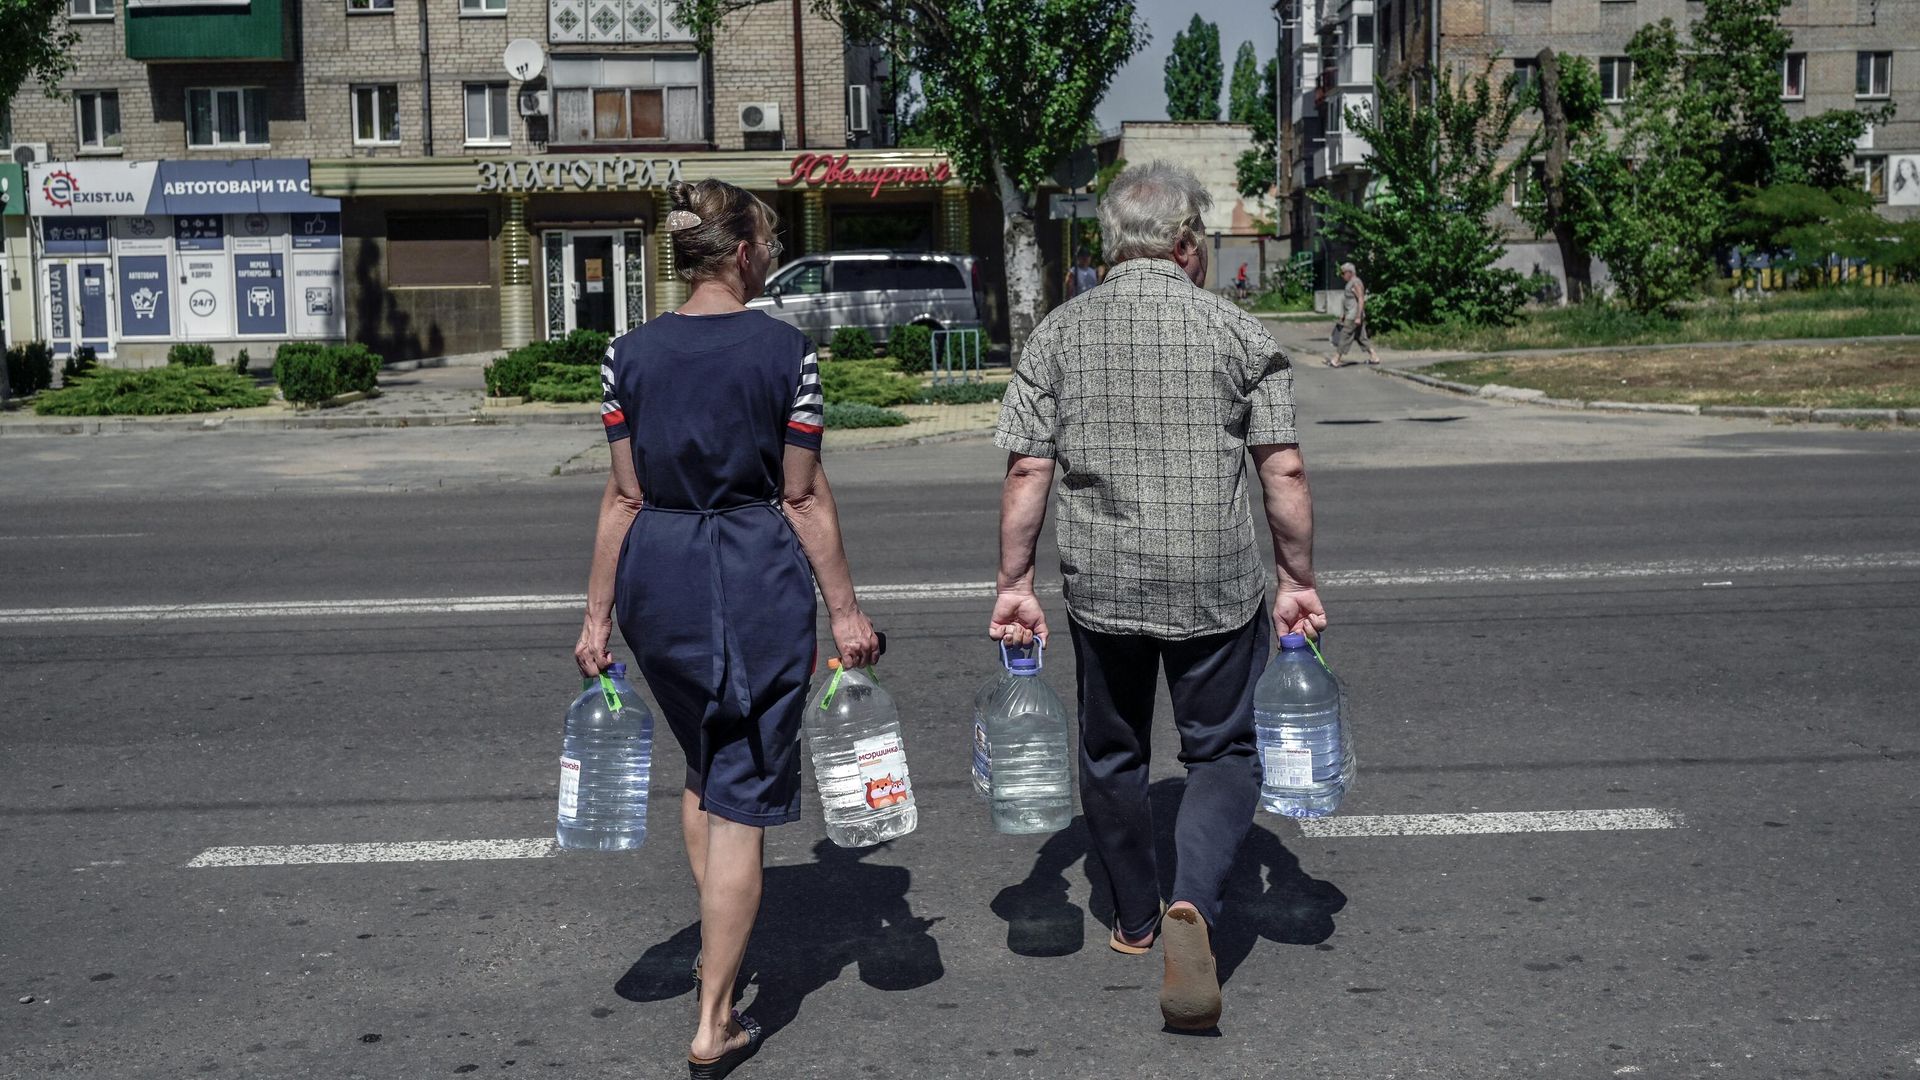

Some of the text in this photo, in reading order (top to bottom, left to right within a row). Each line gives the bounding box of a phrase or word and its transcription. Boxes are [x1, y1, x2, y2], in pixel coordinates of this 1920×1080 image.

[163, 180, 274, 195] АВТОТОВАРИ
[276, 179, 298, 193] ТА
[73, 192, 135, 203] EXIST.UA
[50, 270, 64, 338] EXIST.UA
[192, 298, 214, 308] 24/7
